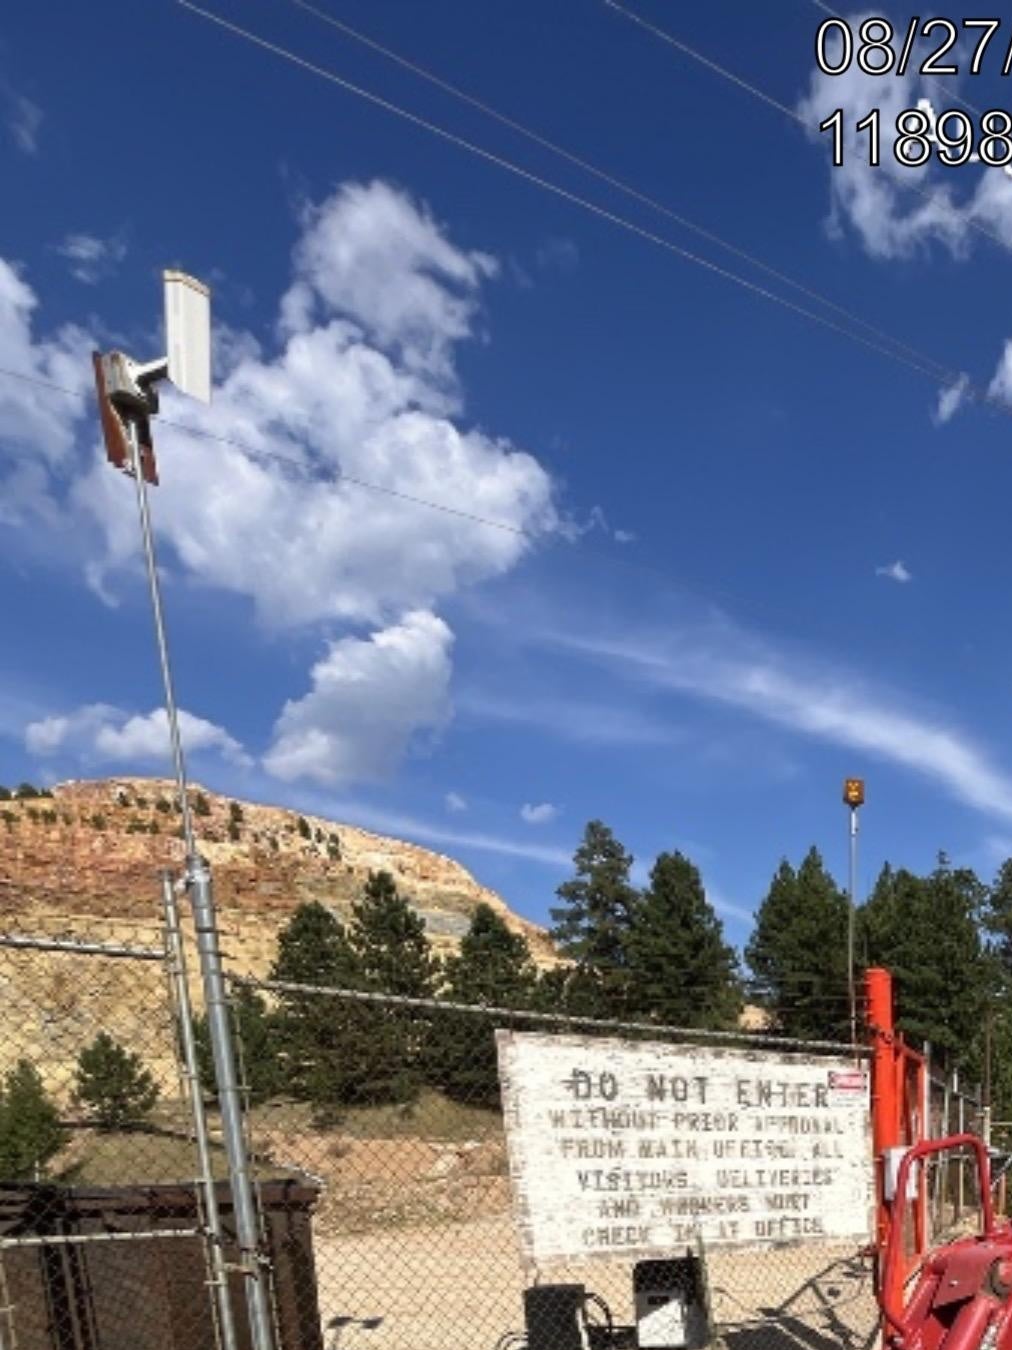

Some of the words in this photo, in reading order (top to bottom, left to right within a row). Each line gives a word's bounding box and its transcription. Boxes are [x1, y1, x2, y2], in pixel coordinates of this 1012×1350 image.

[566, 1068, 619, 1102] DO
[646, 1073, 709, 1105] NOT
[735, 1079, 829, 1109] ENTER
[549, 1108, 657, 1130] WITHOUT
[673, 1112, 740, 1132] PRIOR
[560, 1138, 625, 1159] FROM
[638, 1138, 697, 1159] MAIN
